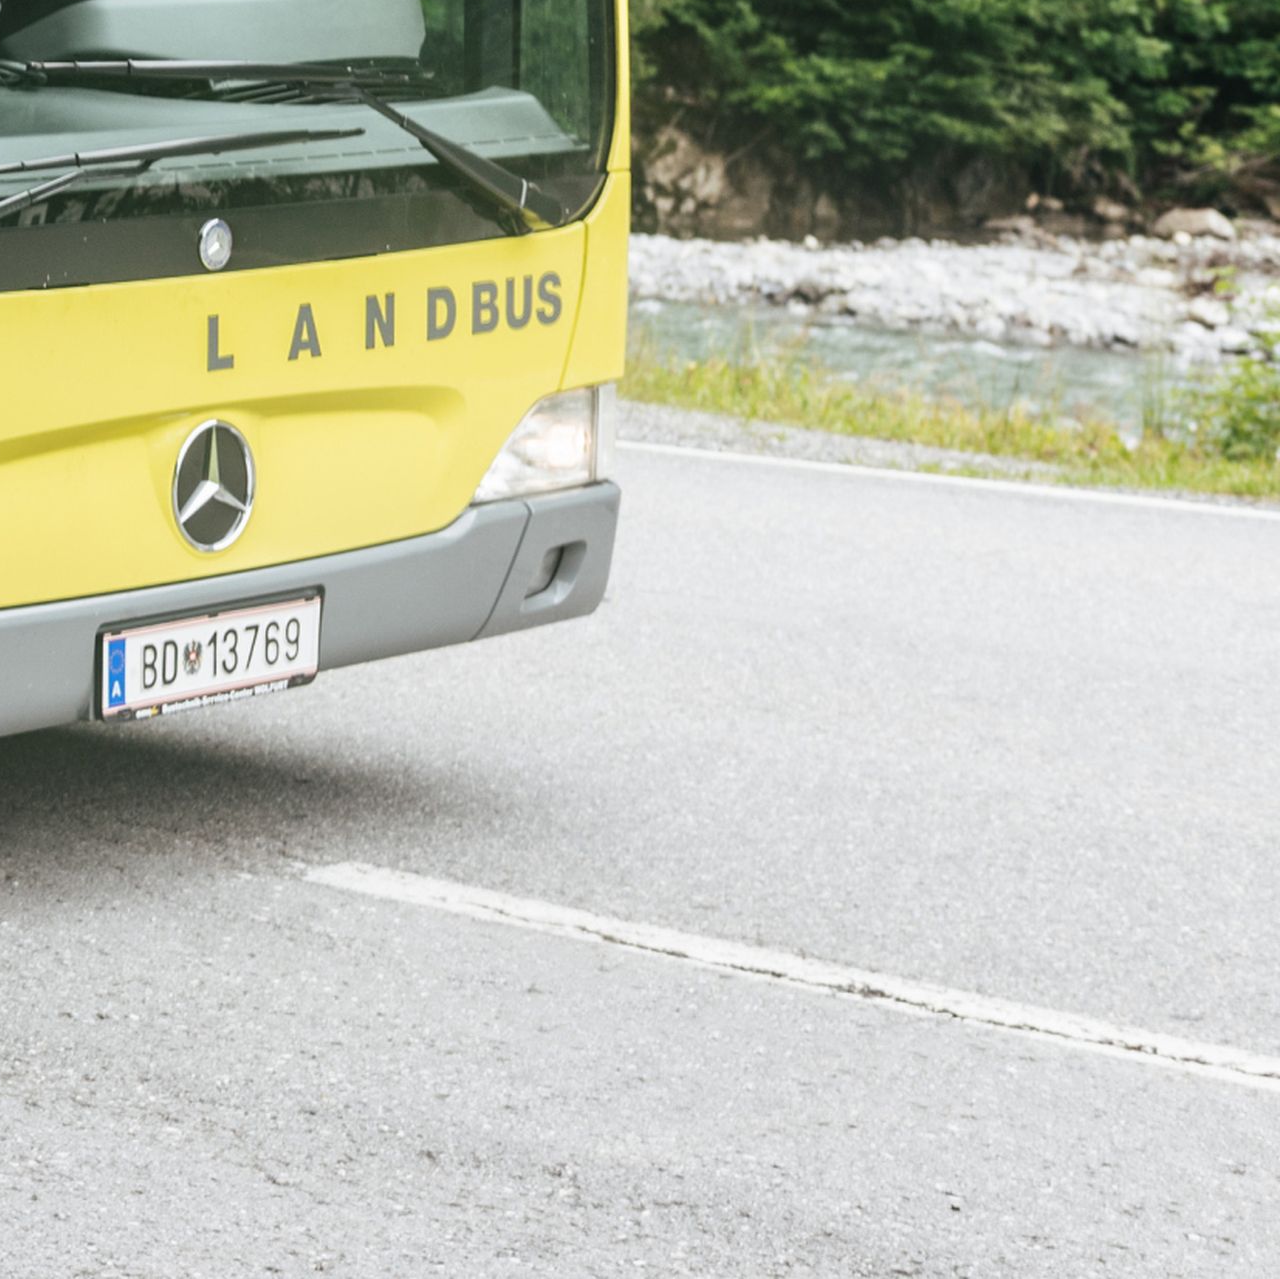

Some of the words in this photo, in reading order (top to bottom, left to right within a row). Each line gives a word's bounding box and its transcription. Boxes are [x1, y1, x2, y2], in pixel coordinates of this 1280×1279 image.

[206, 269, 563, 372] LANDBUS
[111, 680, 122, 699] A
[142, 640, 179, 690] BD
[207, 617, 302, 677] 13769
